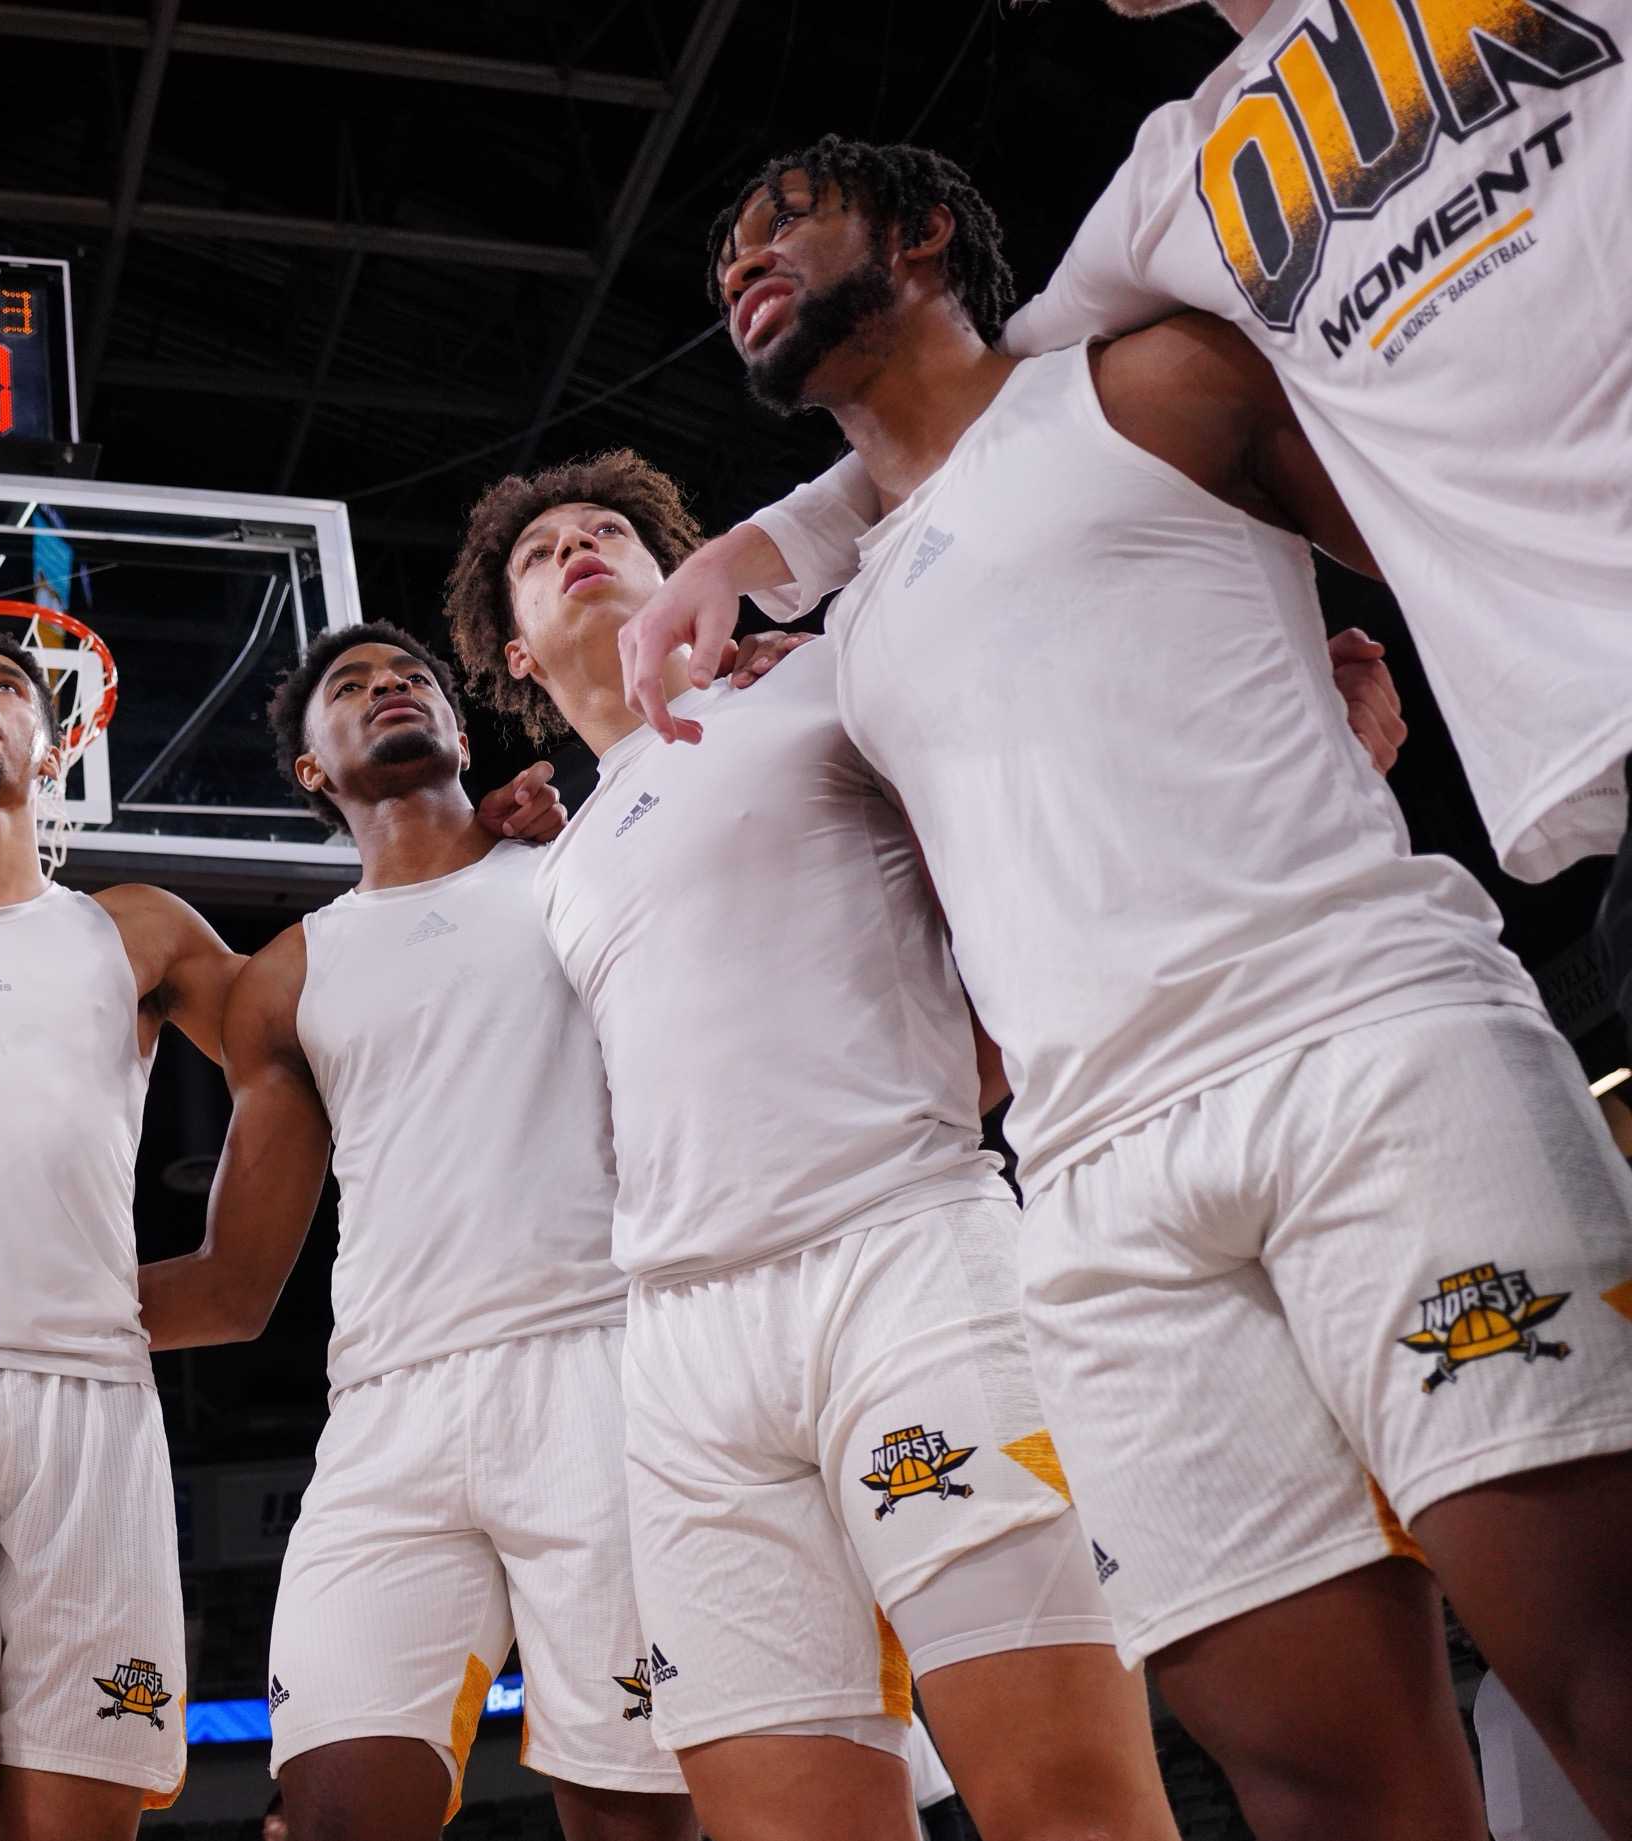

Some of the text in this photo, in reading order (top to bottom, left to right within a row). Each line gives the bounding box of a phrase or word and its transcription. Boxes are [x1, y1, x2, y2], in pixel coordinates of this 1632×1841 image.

[1319, 111, 1573, 359] MOMENT
[1382, 334, 1406, 367] NKU
[1447, 230, 1537, 302] BASKETBALL
[615, 796, 660, 838] adidas
[1441, 1263, 1496, 1292] NKU
[884, 1426, 922, 1446] NKU
[131, 1661, 155, 1672] NKU
